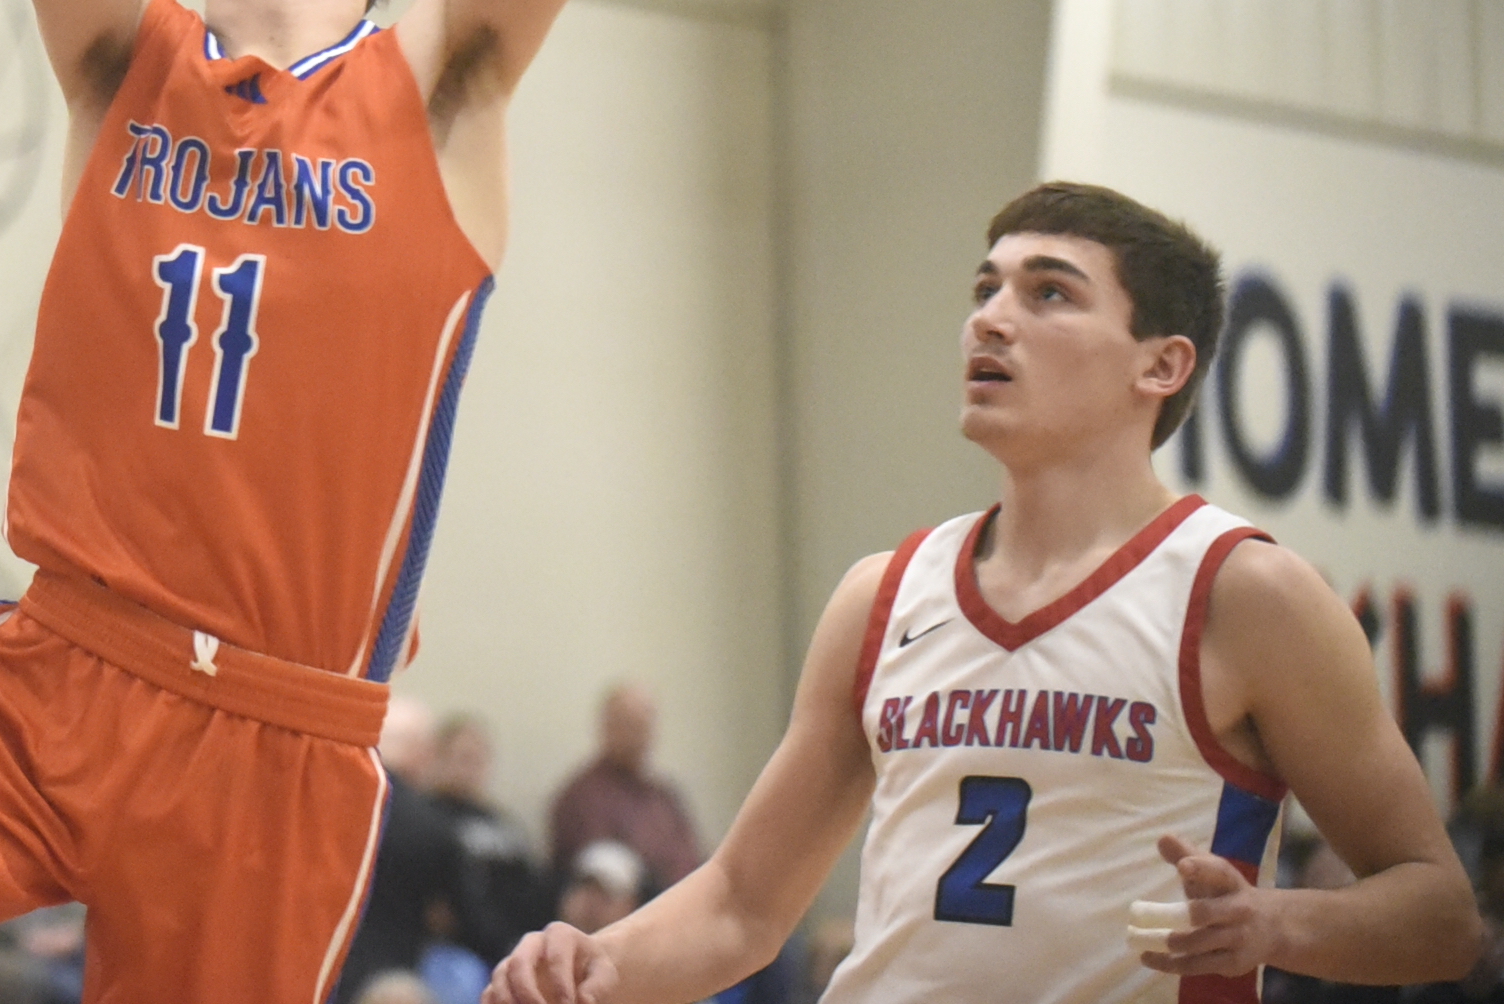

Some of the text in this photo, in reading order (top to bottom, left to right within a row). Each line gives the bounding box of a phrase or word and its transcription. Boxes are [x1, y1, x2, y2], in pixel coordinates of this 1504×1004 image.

[110, 119, 376, 234] TROJANS
[152, 243, 266, 440] 11
[1180, 268, 1504, 531] OME
[876, 689, 1157, 763] BLACKHAWKS
[934, 775, 1032, 927] 2
